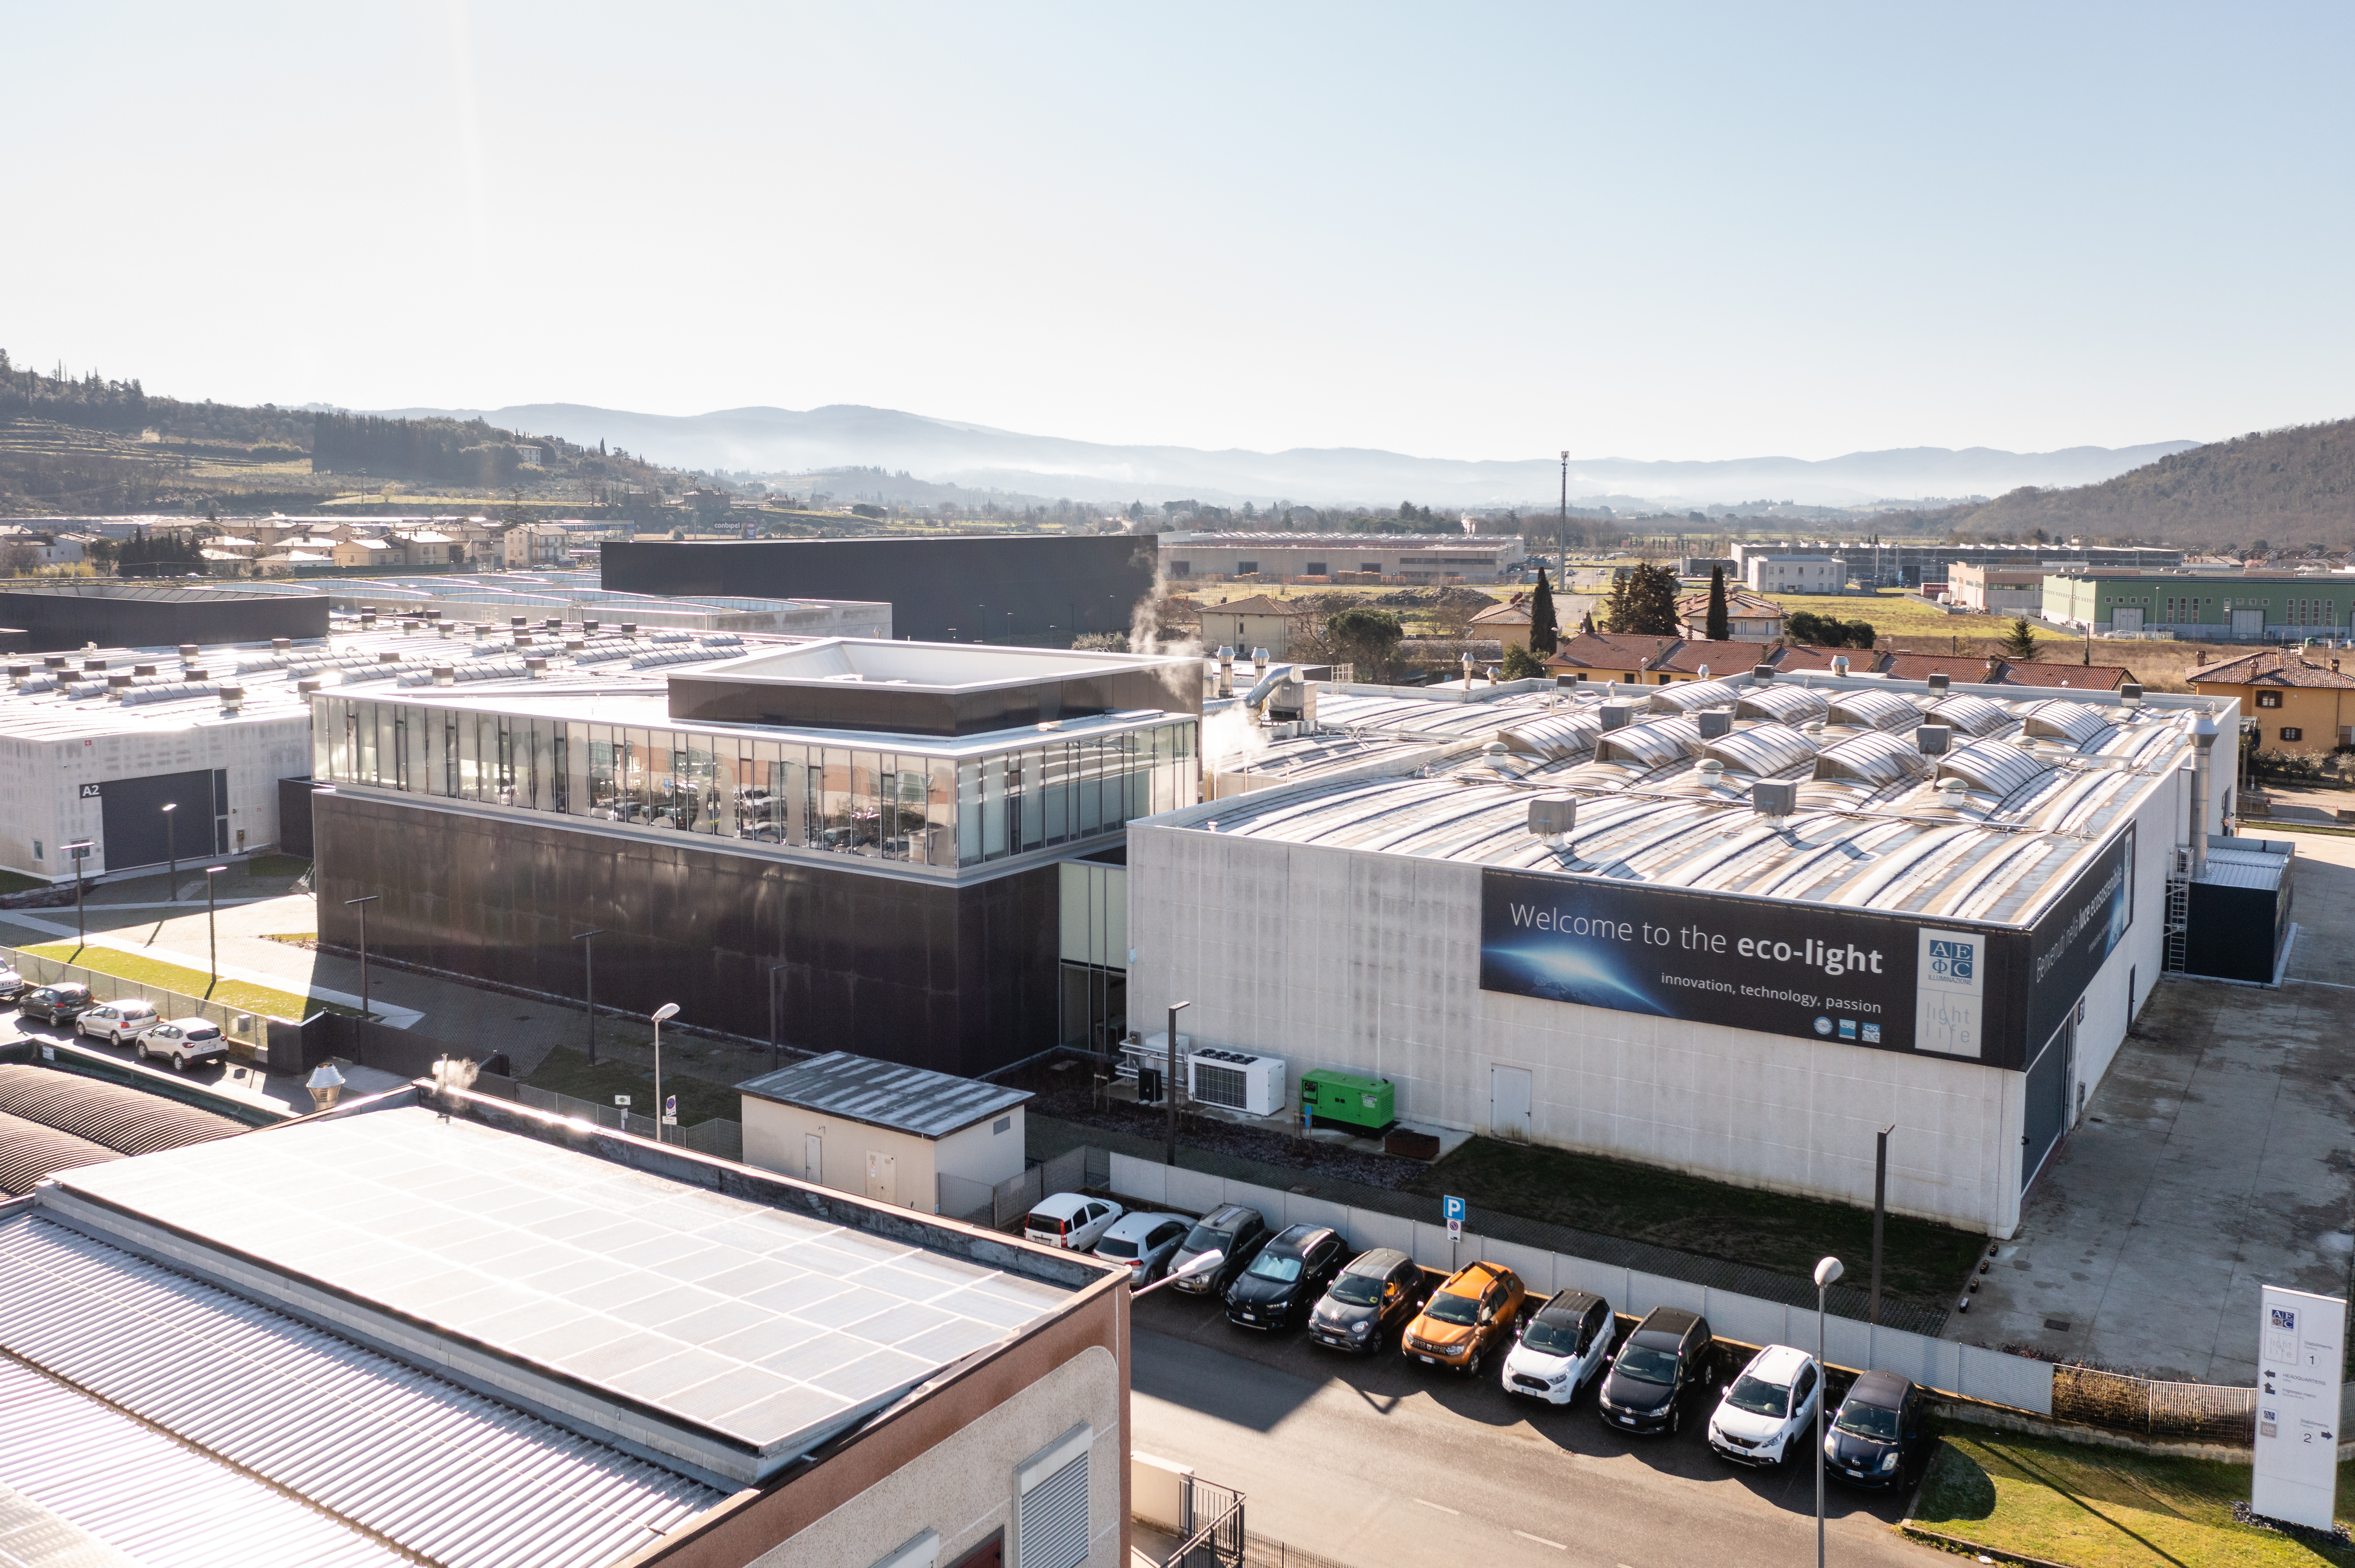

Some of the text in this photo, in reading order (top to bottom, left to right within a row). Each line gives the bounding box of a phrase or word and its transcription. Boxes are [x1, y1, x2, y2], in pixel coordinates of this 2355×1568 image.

[82, 785, 100, 796] A2
[2036, 929, 2065, 983] Benvenuti
[2065, 916, 2078, 948] nella
[2078, 904, 2090, 932] luce
[2090, 863, 2122, 917] ecosostenibile
[1510, 903, 1883, 976] Welcome to the eco-light
[1928, 974, 1973, 985] ILLUMINAZIONE
[1661, 972, 1881, 1013] innovation, technology, passion
[1927, 1002, 1970, 1025] light
[1864, 1024, 1878, 1032] CSQ
[1448, 1199, 1461, 1216] P
[2304, 1340, 2333, 1350] Stabilimento
[2309, 1356, 2314, 1365] 1
[2283, 1373, 2326, 1386] HEADQUARTERS
[2304, 1433, 2311, 1443] 2
